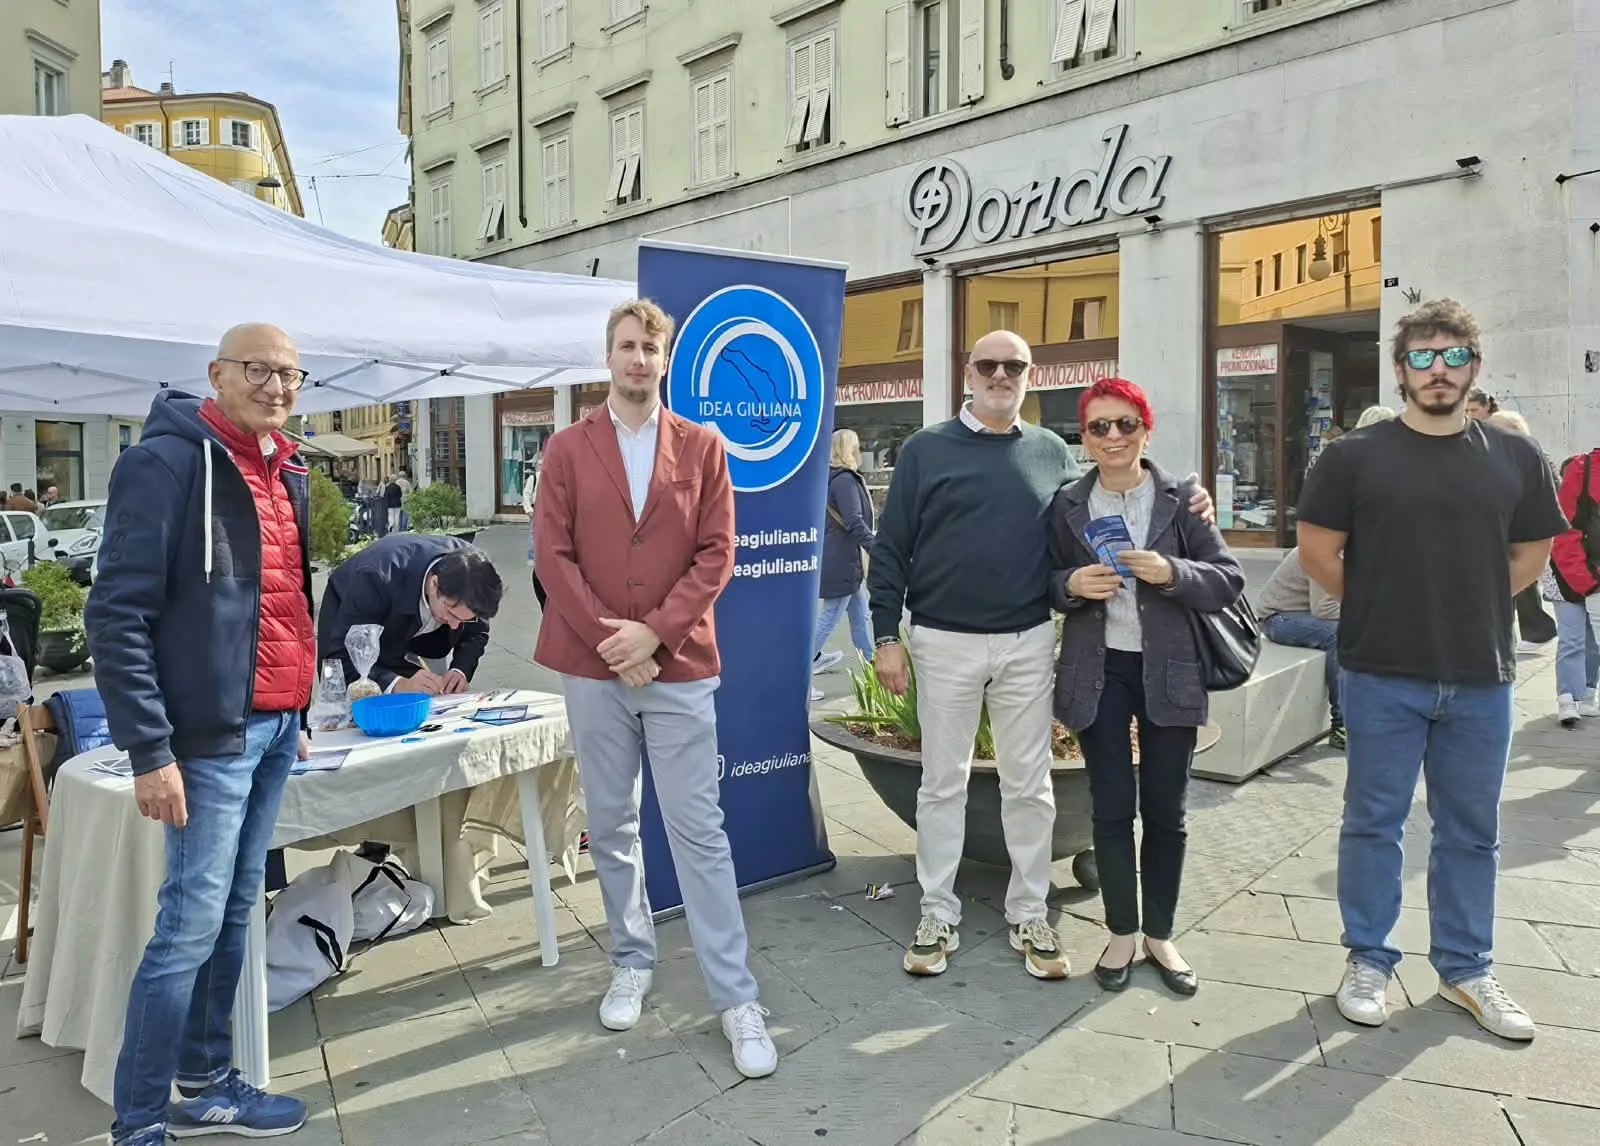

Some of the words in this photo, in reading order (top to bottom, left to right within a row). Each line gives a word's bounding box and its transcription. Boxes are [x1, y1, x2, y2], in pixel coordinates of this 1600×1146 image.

[904, 124, 1172, 257] Donda
[1030, 360, 1119, 387] OMOZIONAL
[1220, 359, 1276, 372] PROMOZIONALE
[699, 401, 733, 416] IDEA
[736, 401, 802, 417] GIULIANA
[731, 555, 818, 578] eagiuliana.it
